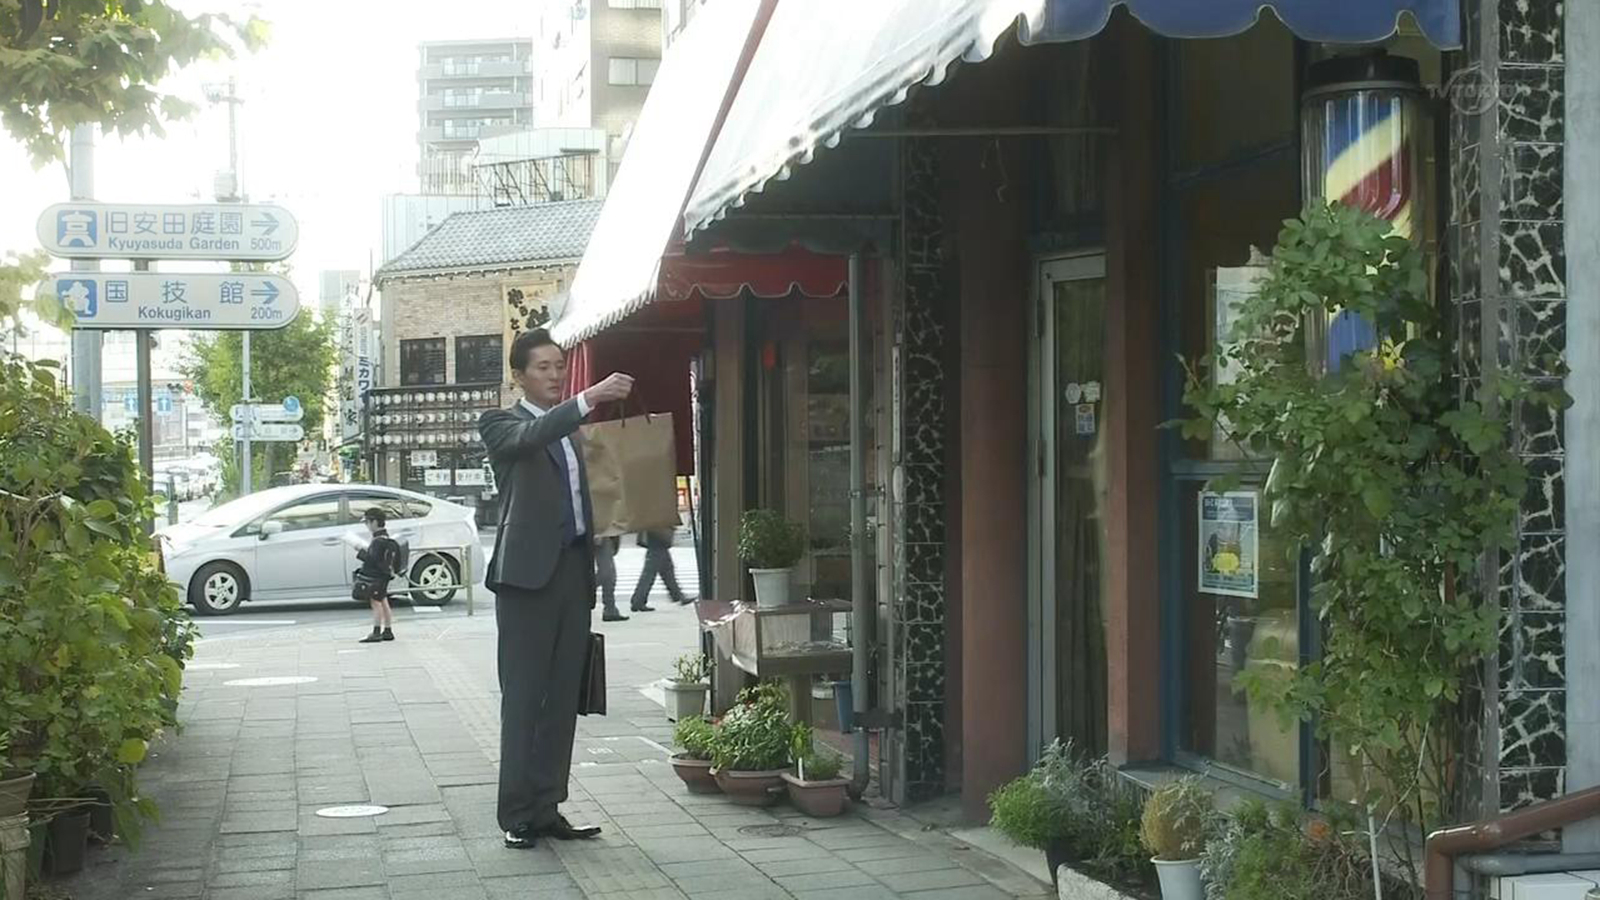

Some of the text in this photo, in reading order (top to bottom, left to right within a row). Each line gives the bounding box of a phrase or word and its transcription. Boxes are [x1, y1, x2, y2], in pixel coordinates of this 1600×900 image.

[105, 211, 243, 234] 旧安田庭園
[108, 237, 282, 251] Kyuyasuda Garden 500m
[105, 281, 244, 304] 国技館
[138, 306, 282, 321] Kokugikan 200m
